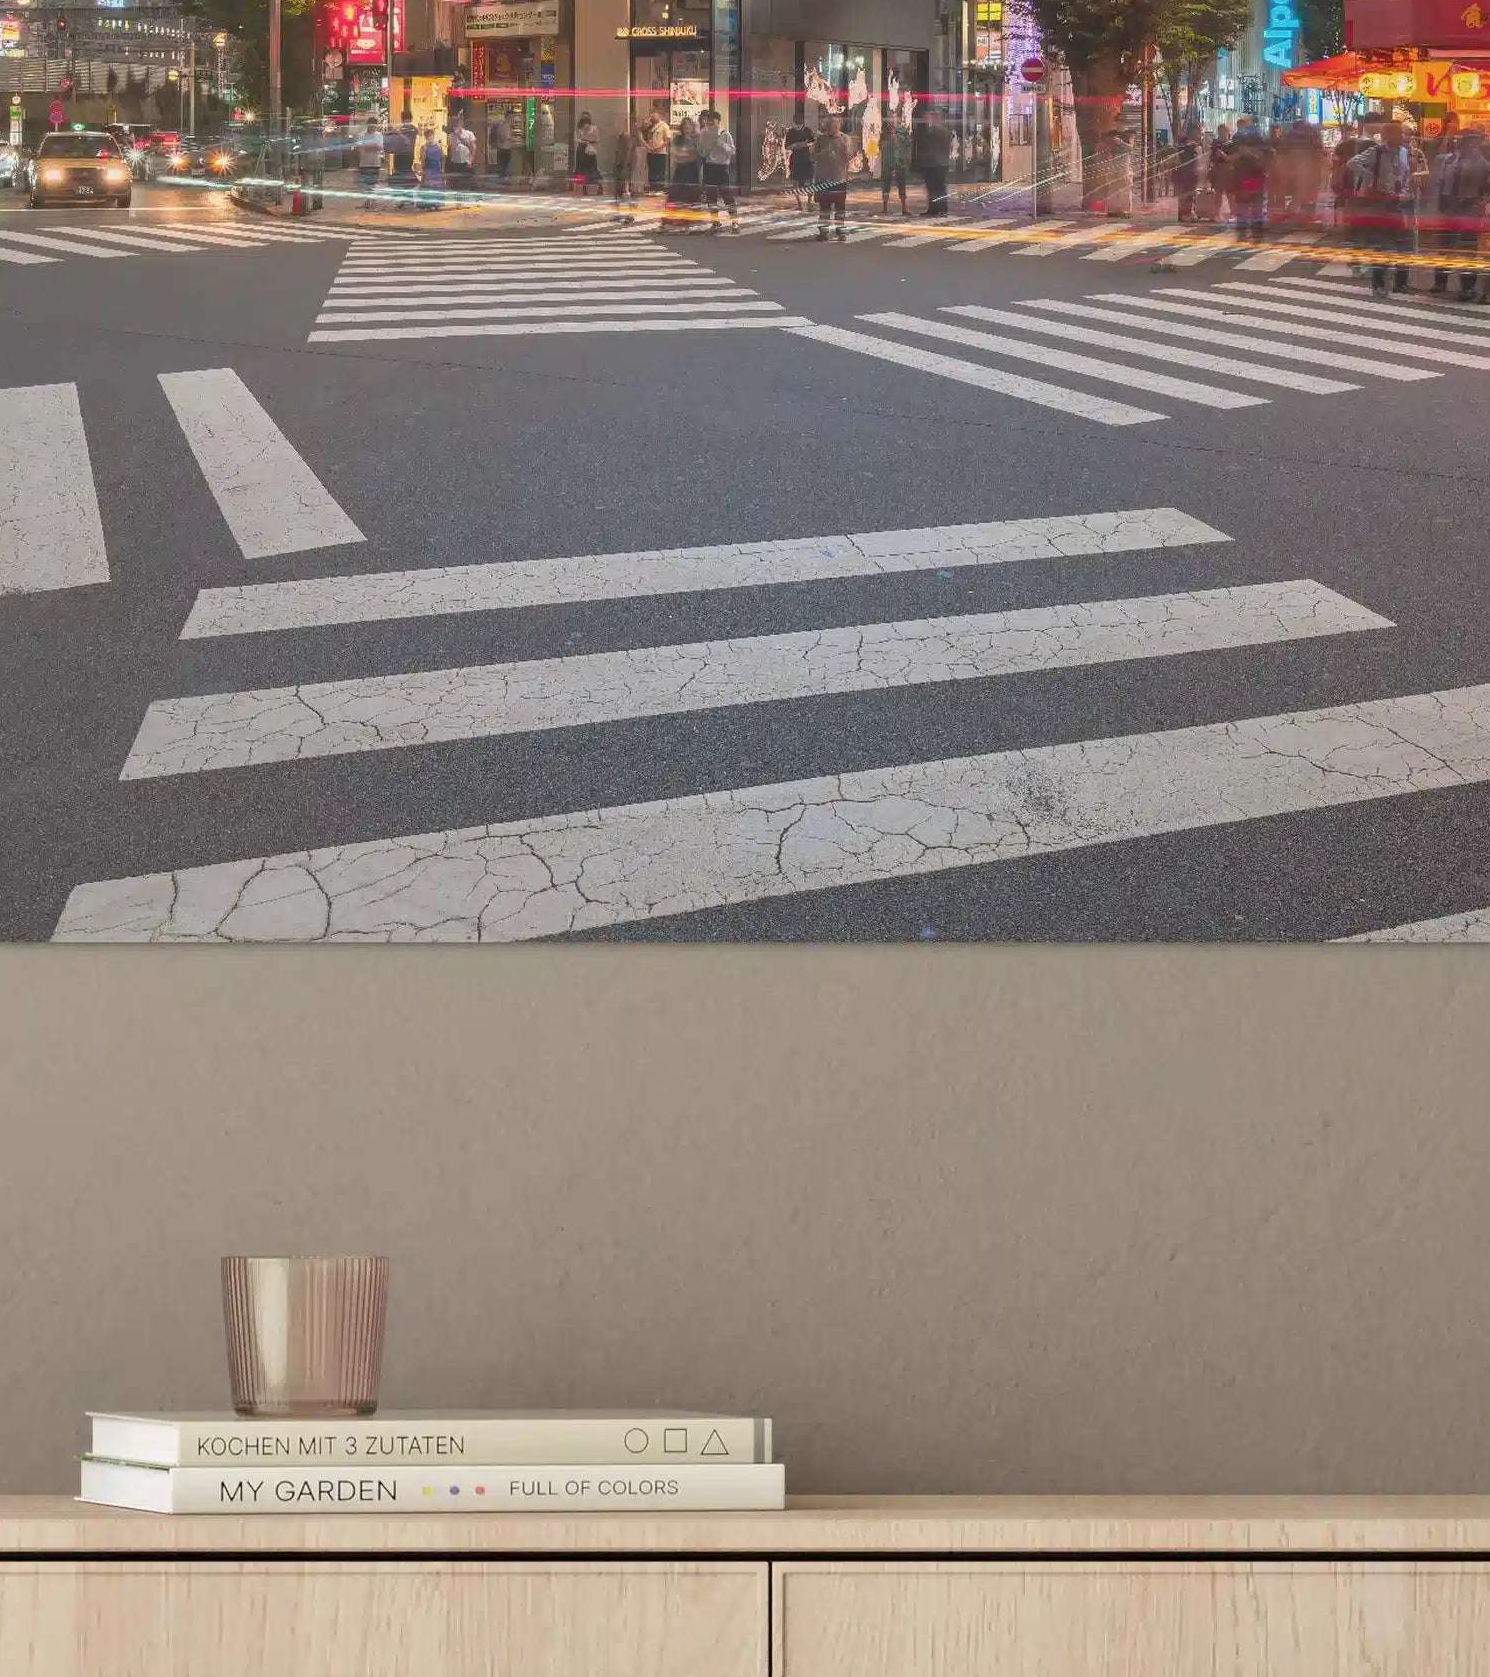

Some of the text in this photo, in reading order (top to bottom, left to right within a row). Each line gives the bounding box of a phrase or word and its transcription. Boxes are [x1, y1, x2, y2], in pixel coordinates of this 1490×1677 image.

[198, 1435, 466, 1456] KOCHEN MIT 3 ZUTATEN
[220, 1479, 680, 1502] MY GARDEN FULL OF COLORS
